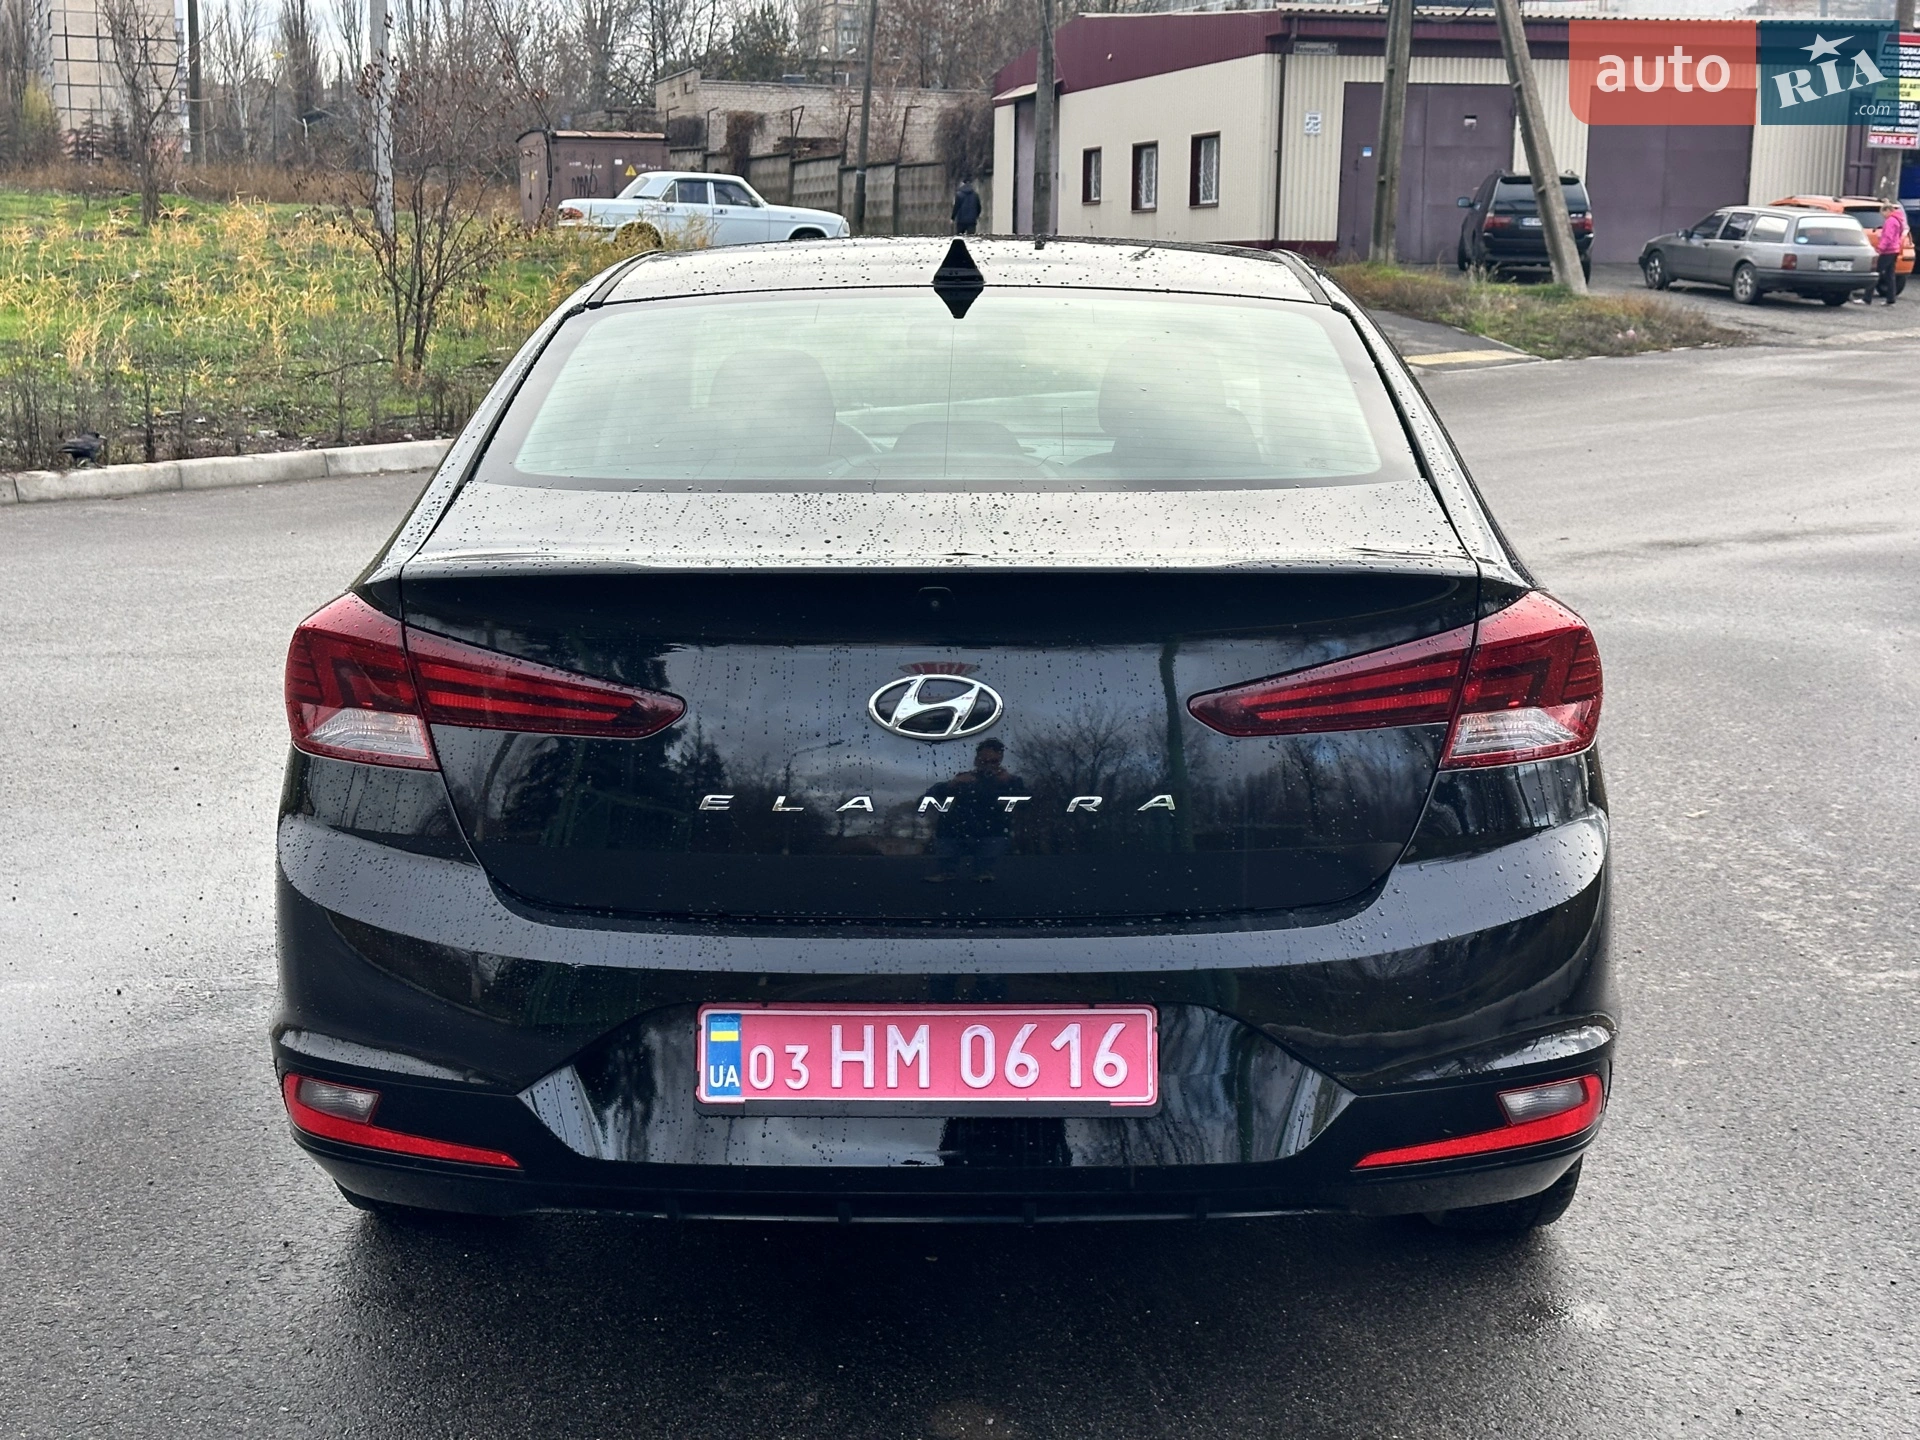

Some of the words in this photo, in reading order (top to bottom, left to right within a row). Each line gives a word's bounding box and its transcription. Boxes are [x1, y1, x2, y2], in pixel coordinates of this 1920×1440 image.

[698, 794, 1177, 813] ELANTRA
[748, 1044, 810, 1091] 03
[831, 1024, 930, 1089] HM
[960, 1022, 1128, 1089] 0616
[709, 1065, 740, 1089] UA
